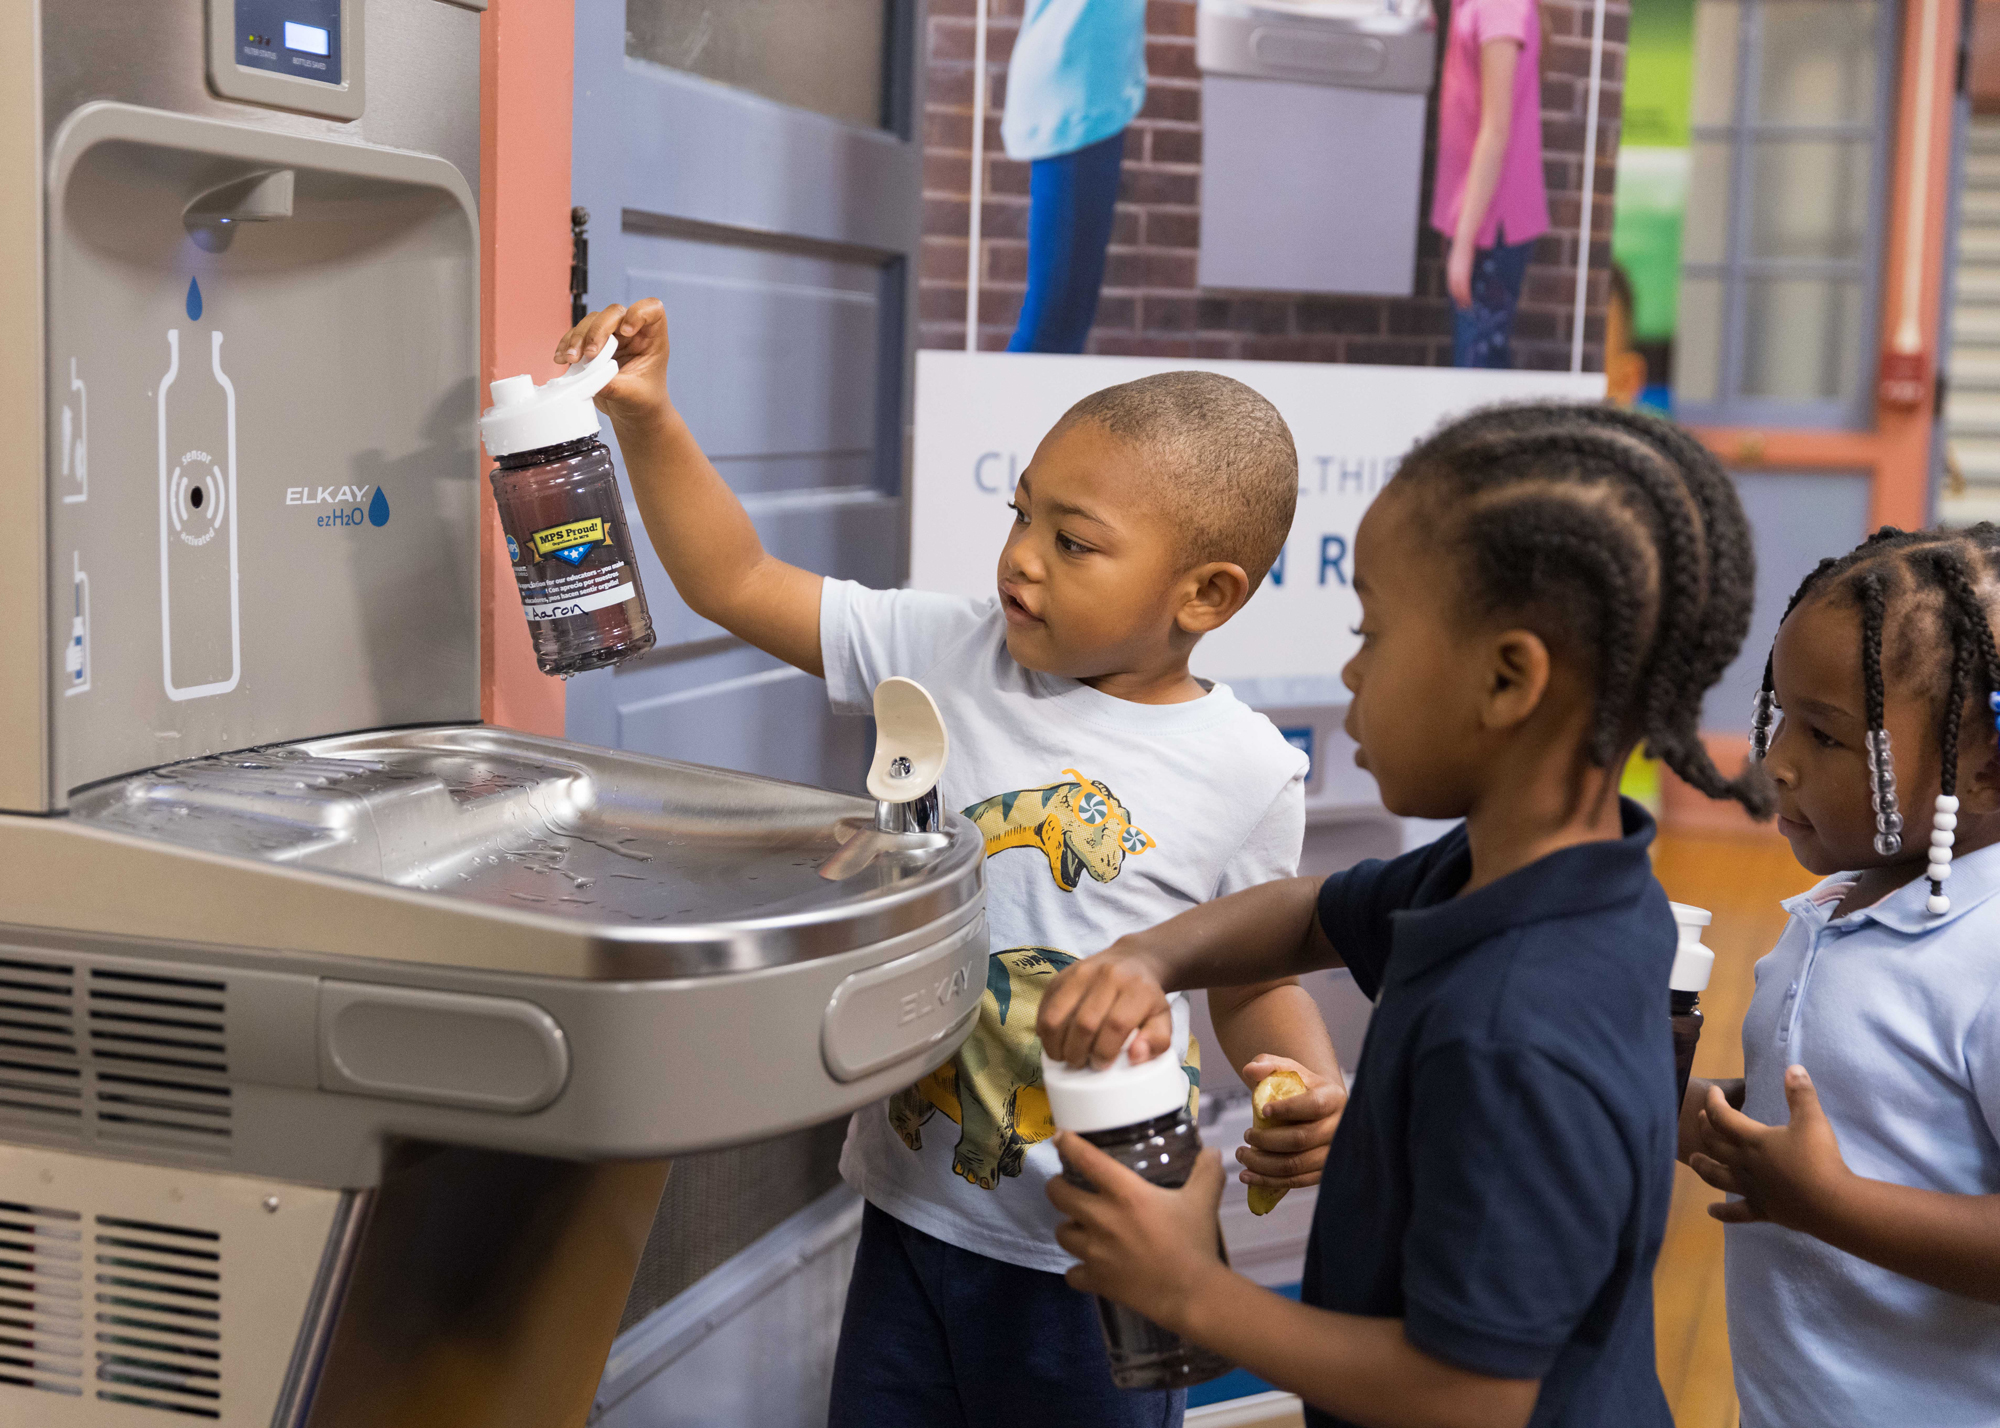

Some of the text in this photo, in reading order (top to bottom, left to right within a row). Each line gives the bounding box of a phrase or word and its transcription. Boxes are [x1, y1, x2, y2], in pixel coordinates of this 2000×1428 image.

[292, 57, 327, 70] BOTTLES SAVED
[182, 450, 212, 466] sensor
[286, 485, 369, 505] ELKAY
[181, 526, 215, 546] activated
[539, 522, 598, 545] MPS Proud!
[566, 569, 597, 581] educators
[601, 565, 612, 574] you
[612, 560, 625, 569] make
[560, 581, 583, 593] aprecio
[583, 578, 594, 588] por
[594, 571, 619, 582] nuestros
[561, 590, 580, 599] hacen
[580, 585, 598, 595] sentir
[532, 604, 589, 620] Aaron
[899, 961, 973, 1027] ELKAY
